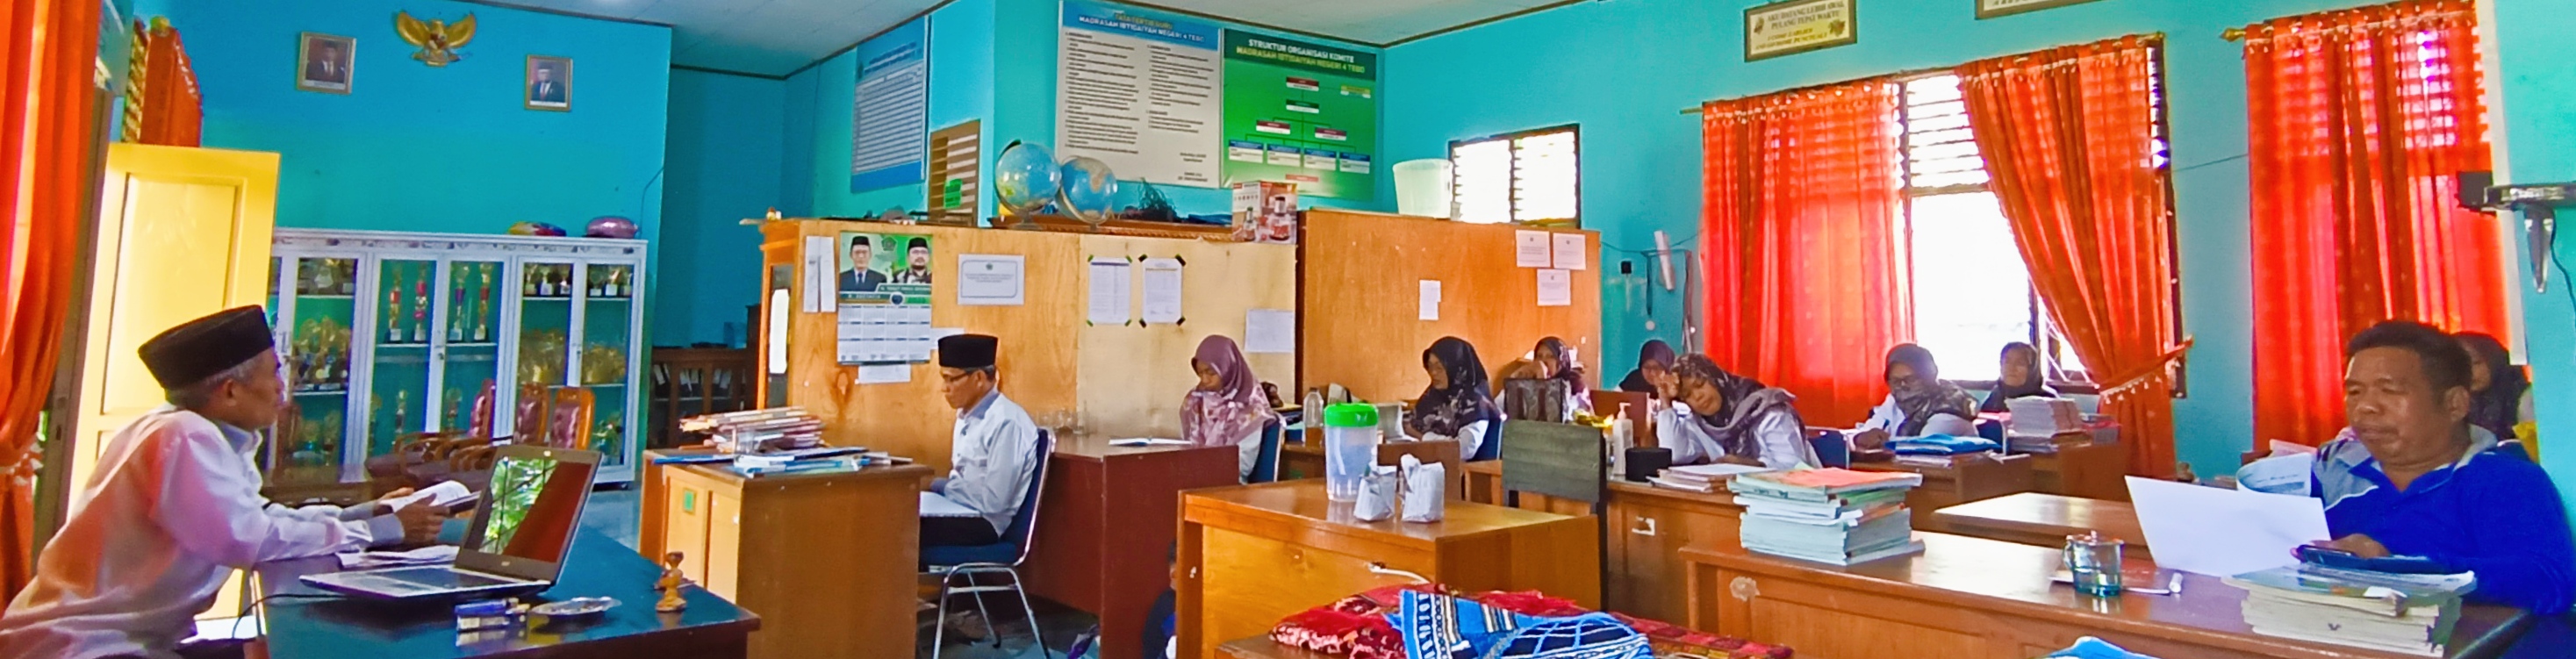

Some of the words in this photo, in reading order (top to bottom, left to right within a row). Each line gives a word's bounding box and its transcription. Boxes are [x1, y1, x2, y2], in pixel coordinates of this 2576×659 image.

[1079, 16, 1119, 26] MADRASAH
[1119, 22, 1158, 33] IBTIDAIYAH
[1158, 29, 1181, 38] NEGERI
[1771, 18, 1797, 30] PULANG
[1817, 11, 1841, 19] WAKTU
[1236, 46, 1277, 59] MADRASAH
[1317, 59, 1342, 70] NEGERI
[1347, 64, 1366, 74] TEBO
[1248, 39, 1287, 53] STRUKTUR
[1288, 45, 1329, 59] ORGANISASI
[1329, 53, 1354, 63] KOMITE
